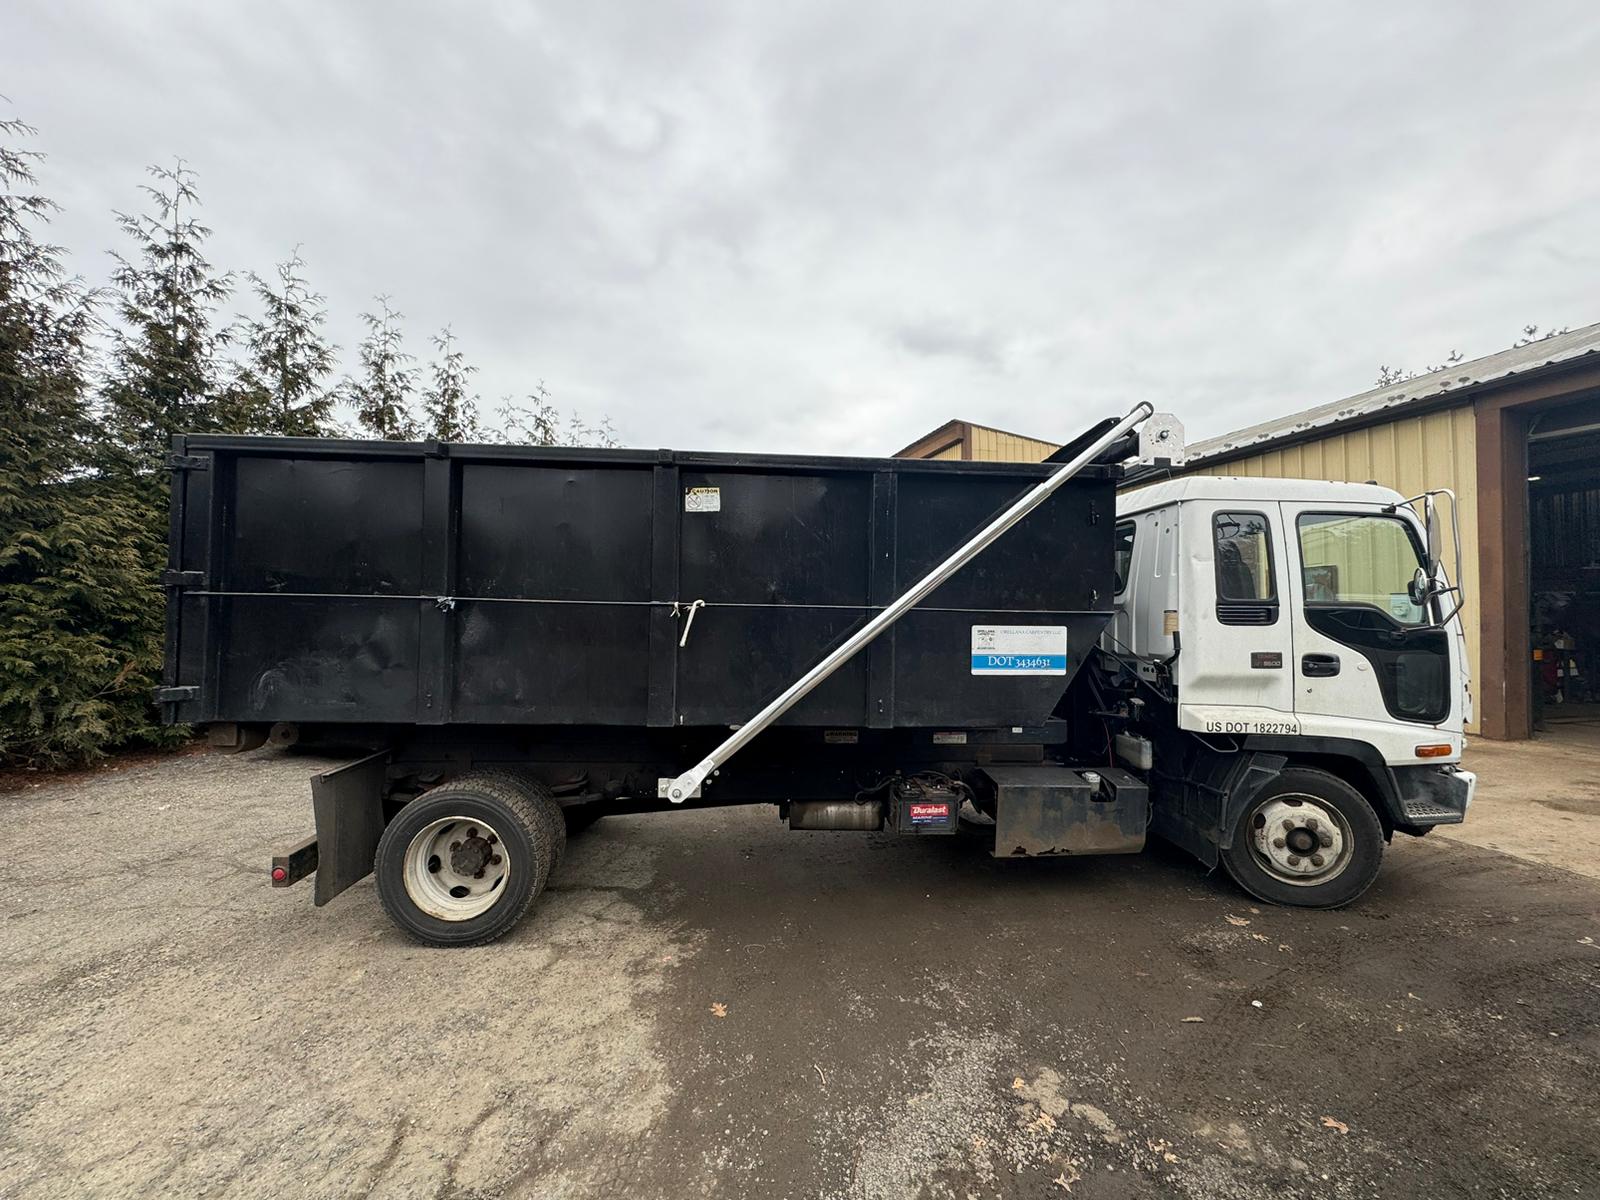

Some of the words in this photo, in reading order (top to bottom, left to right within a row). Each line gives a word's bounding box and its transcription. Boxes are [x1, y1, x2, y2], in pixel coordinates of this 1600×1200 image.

[988, 656, 1014, 666] DOT
[1015, 656, 1051, 668] 3434631
[1206, 721, 1222, 732] US
[1225, 722, 1250, 733] DOT
[1253, 722, 1298, 734] 1822794
[912, 805, 946, 814] Duralast
